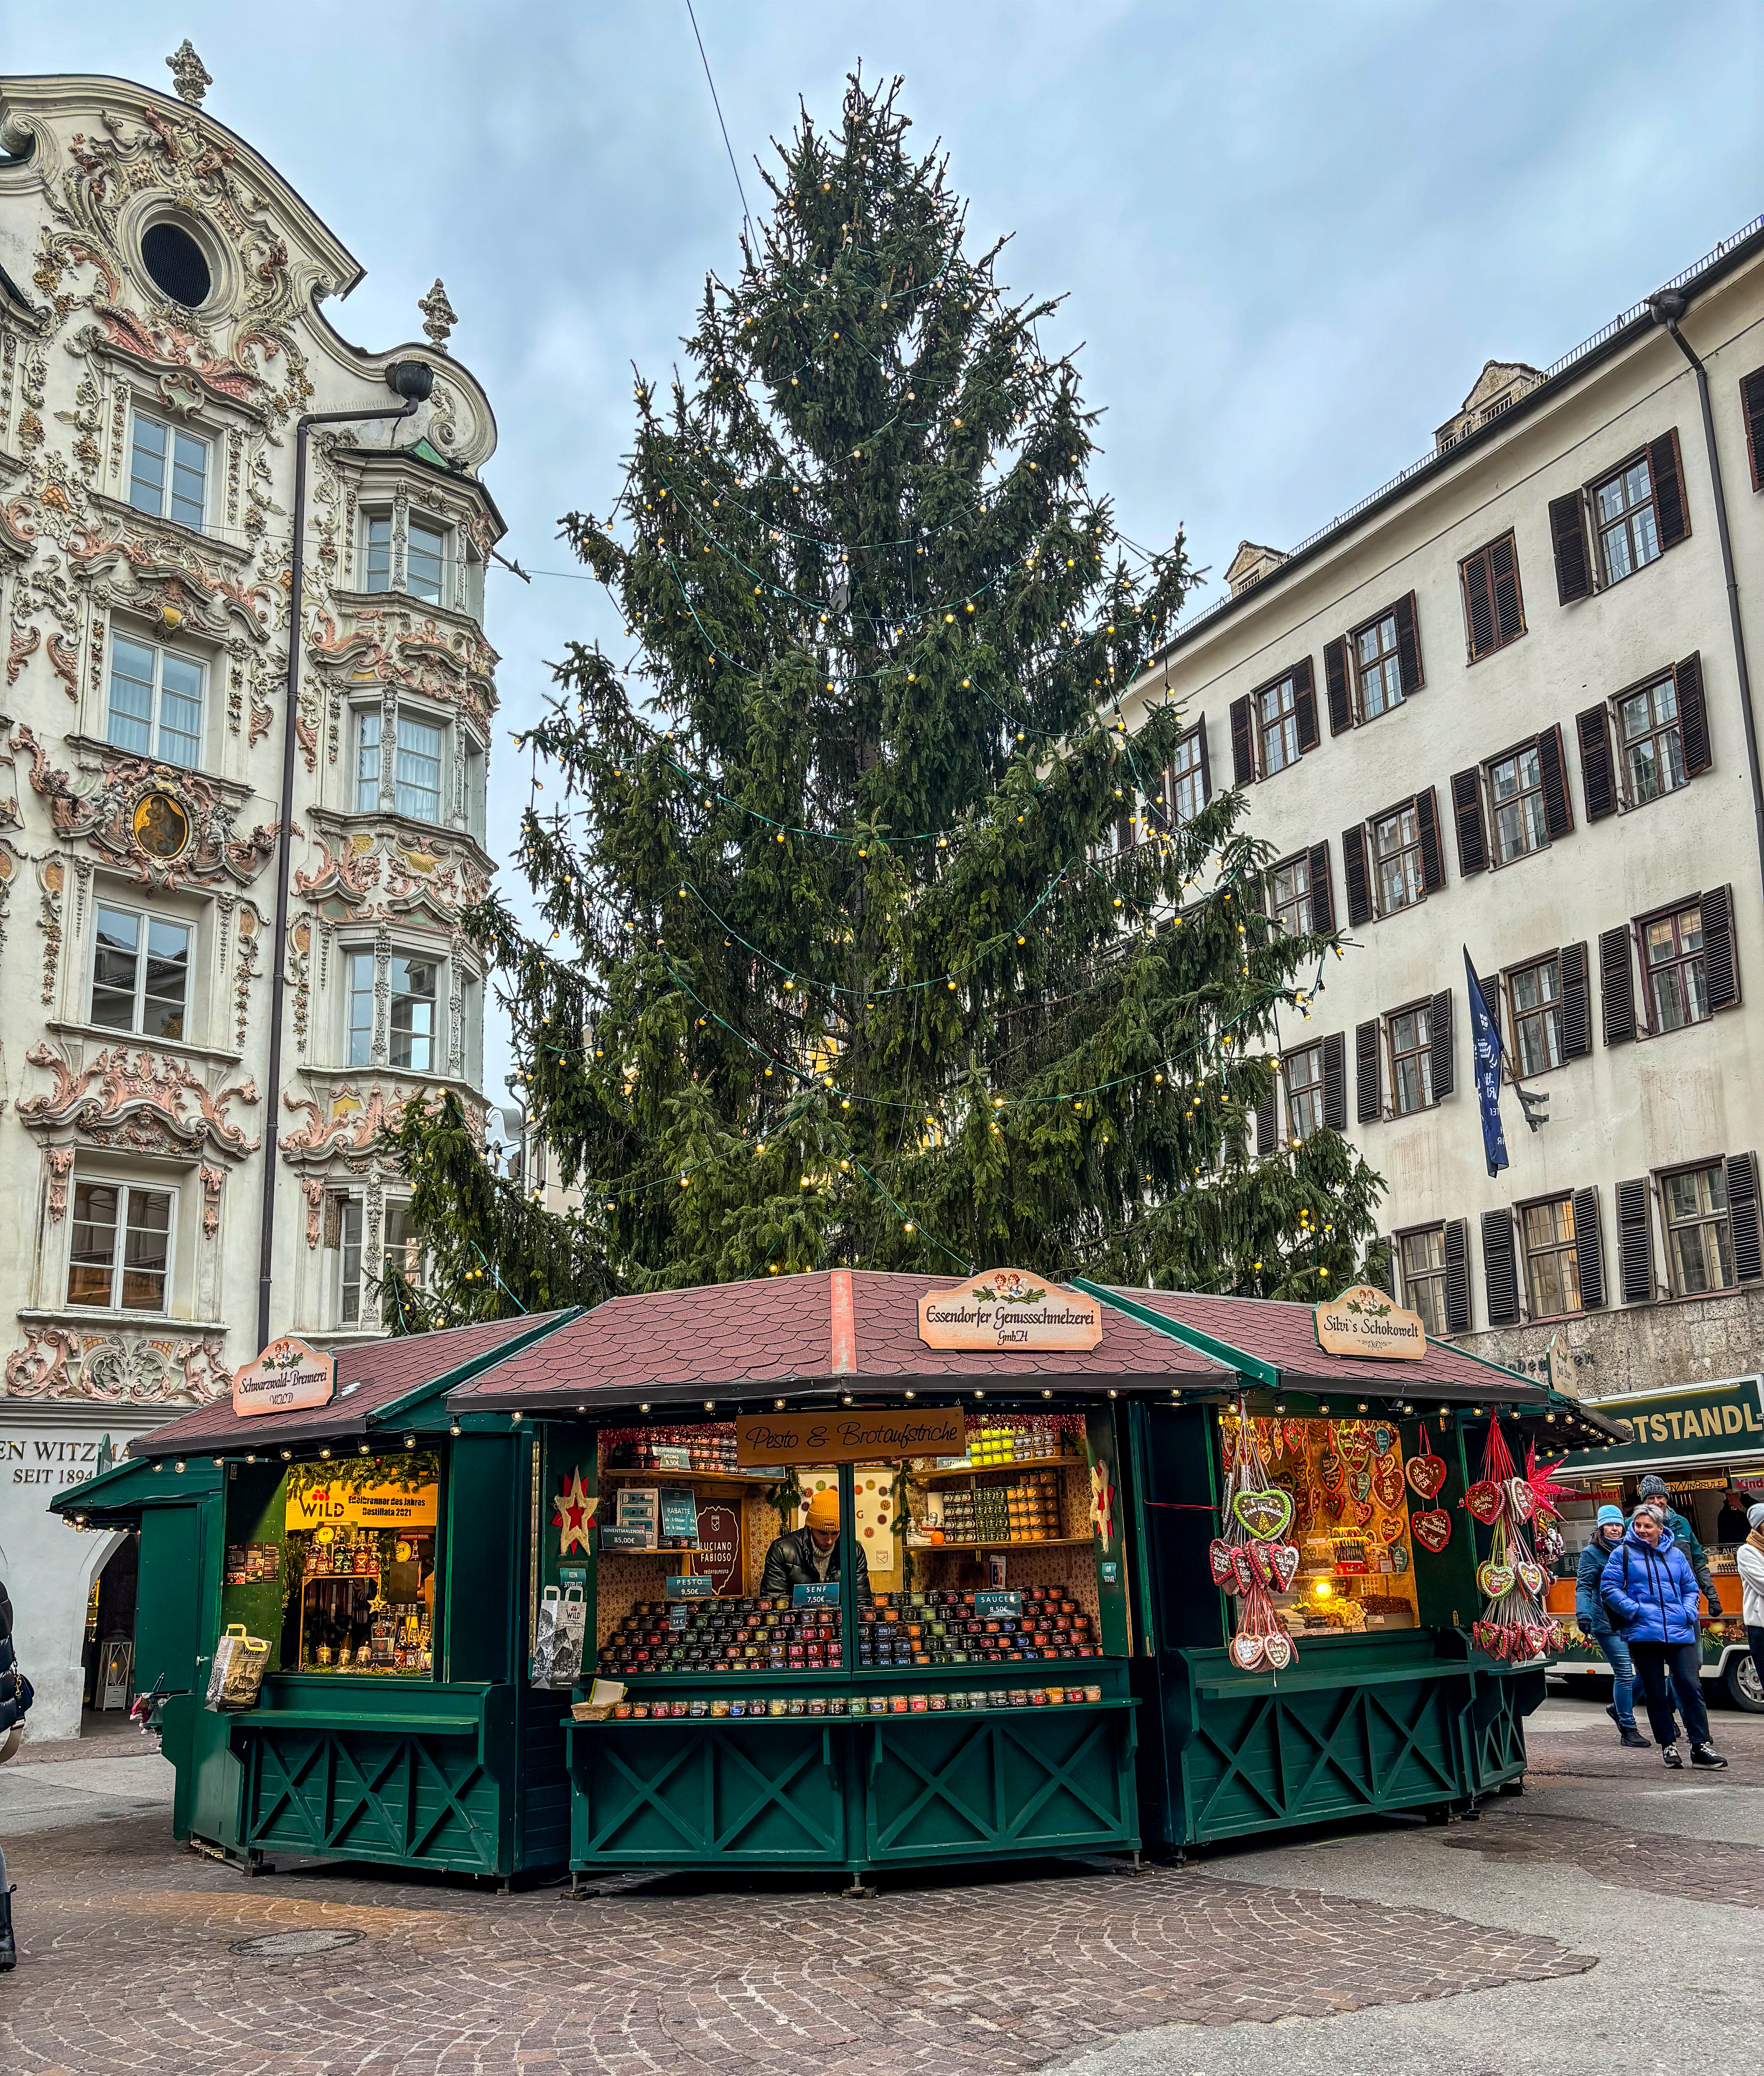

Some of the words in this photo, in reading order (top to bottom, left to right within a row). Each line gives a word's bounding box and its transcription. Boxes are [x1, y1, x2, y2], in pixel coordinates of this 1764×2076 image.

[926, 1305, 991, 1328] Essendorfer
[993, 1306, 1095, 1330] Genussschmelzerei
[1361, 1319, 1419, 1337] Schokowelt
[997, 1330, 1028, 1345] GmbH
[239, 1367, 327, 1394] Schwarzwald-Brennerei
[269, 1392, 293, 1405] WILD
[746, 1426, 799, 1450] Pesto
[806, 1426, 831, 1447] &
[836, 1421, 958, 1449] Brotaufstriche
[13, 1469, 54, 1483] SEIT
[59, 1469, 93, 1484] 1894
[1737, 1477, 1764, 1490] Kind
[298, 1494, 345, 1518] WILD
[390, 1497, 402, 1506] des
[403, 1497, 425, 1506] Jahres
[362, 1507, 394, 1516] Destillata
[396, 1509, 411, 1517] 2021
[700, 1541, 732, 1551] LUCIANO
[701, 1553, 732, 1562] FABIOSO
[566, 1609, 580, 1619] WILD
